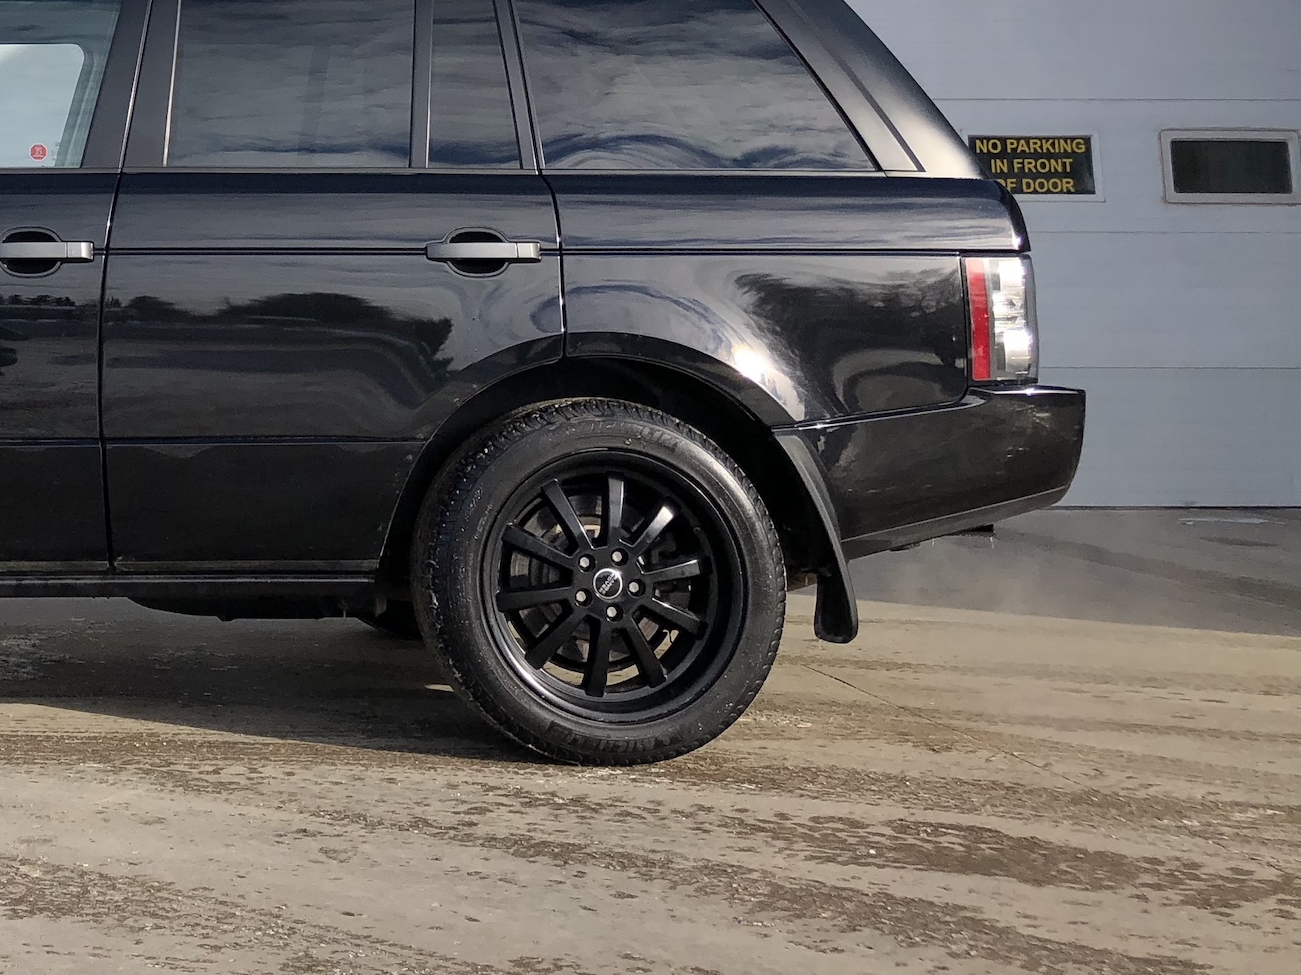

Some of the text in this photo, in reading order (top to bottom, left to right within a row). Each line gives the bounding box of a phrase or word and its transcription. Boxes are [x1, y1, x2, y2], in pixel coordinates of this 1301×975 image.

[975, 138, 1086, 154] NO PARKING
[991, 158, 1073, 174] IN FRONT
[1022, 178, 1075, 193] DOOR
